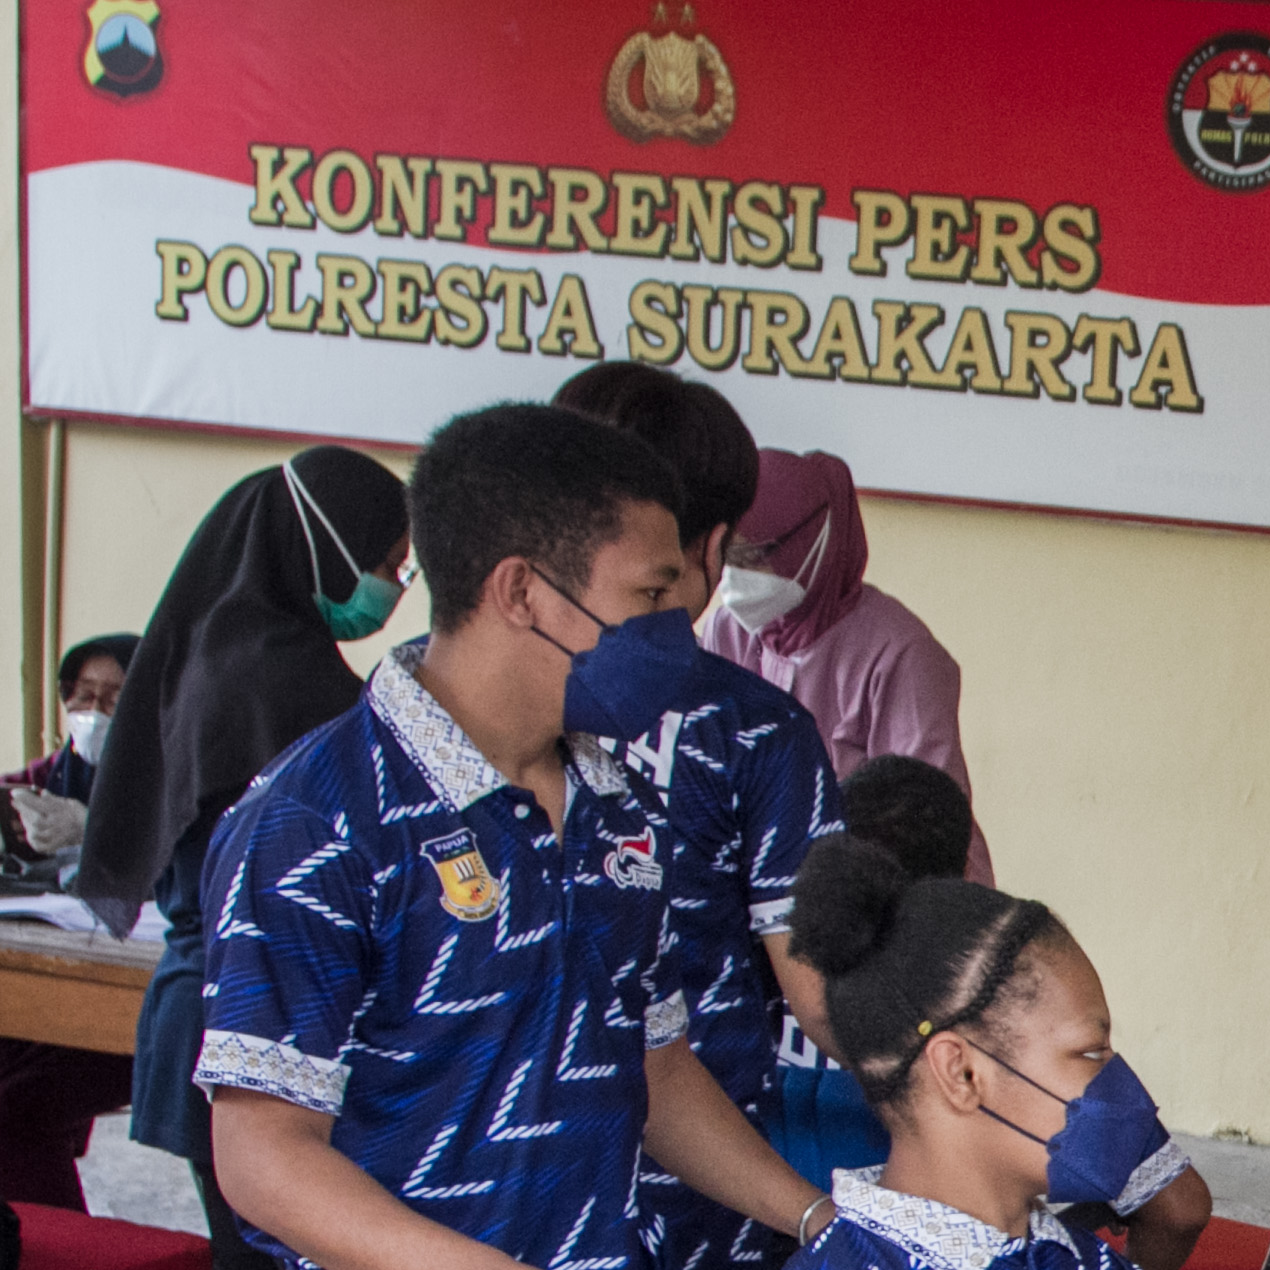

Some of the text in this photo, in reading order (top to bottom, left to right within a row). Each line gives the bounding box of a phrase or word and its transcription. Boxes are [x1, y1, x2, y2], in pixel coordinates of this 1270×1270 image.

[249, 144, 1101, 291] KONFERENSI PERS
[155, 238, 1204, 411] POLRESTA SURAKARTA
[434, 835, 469, 853] PAPUA
